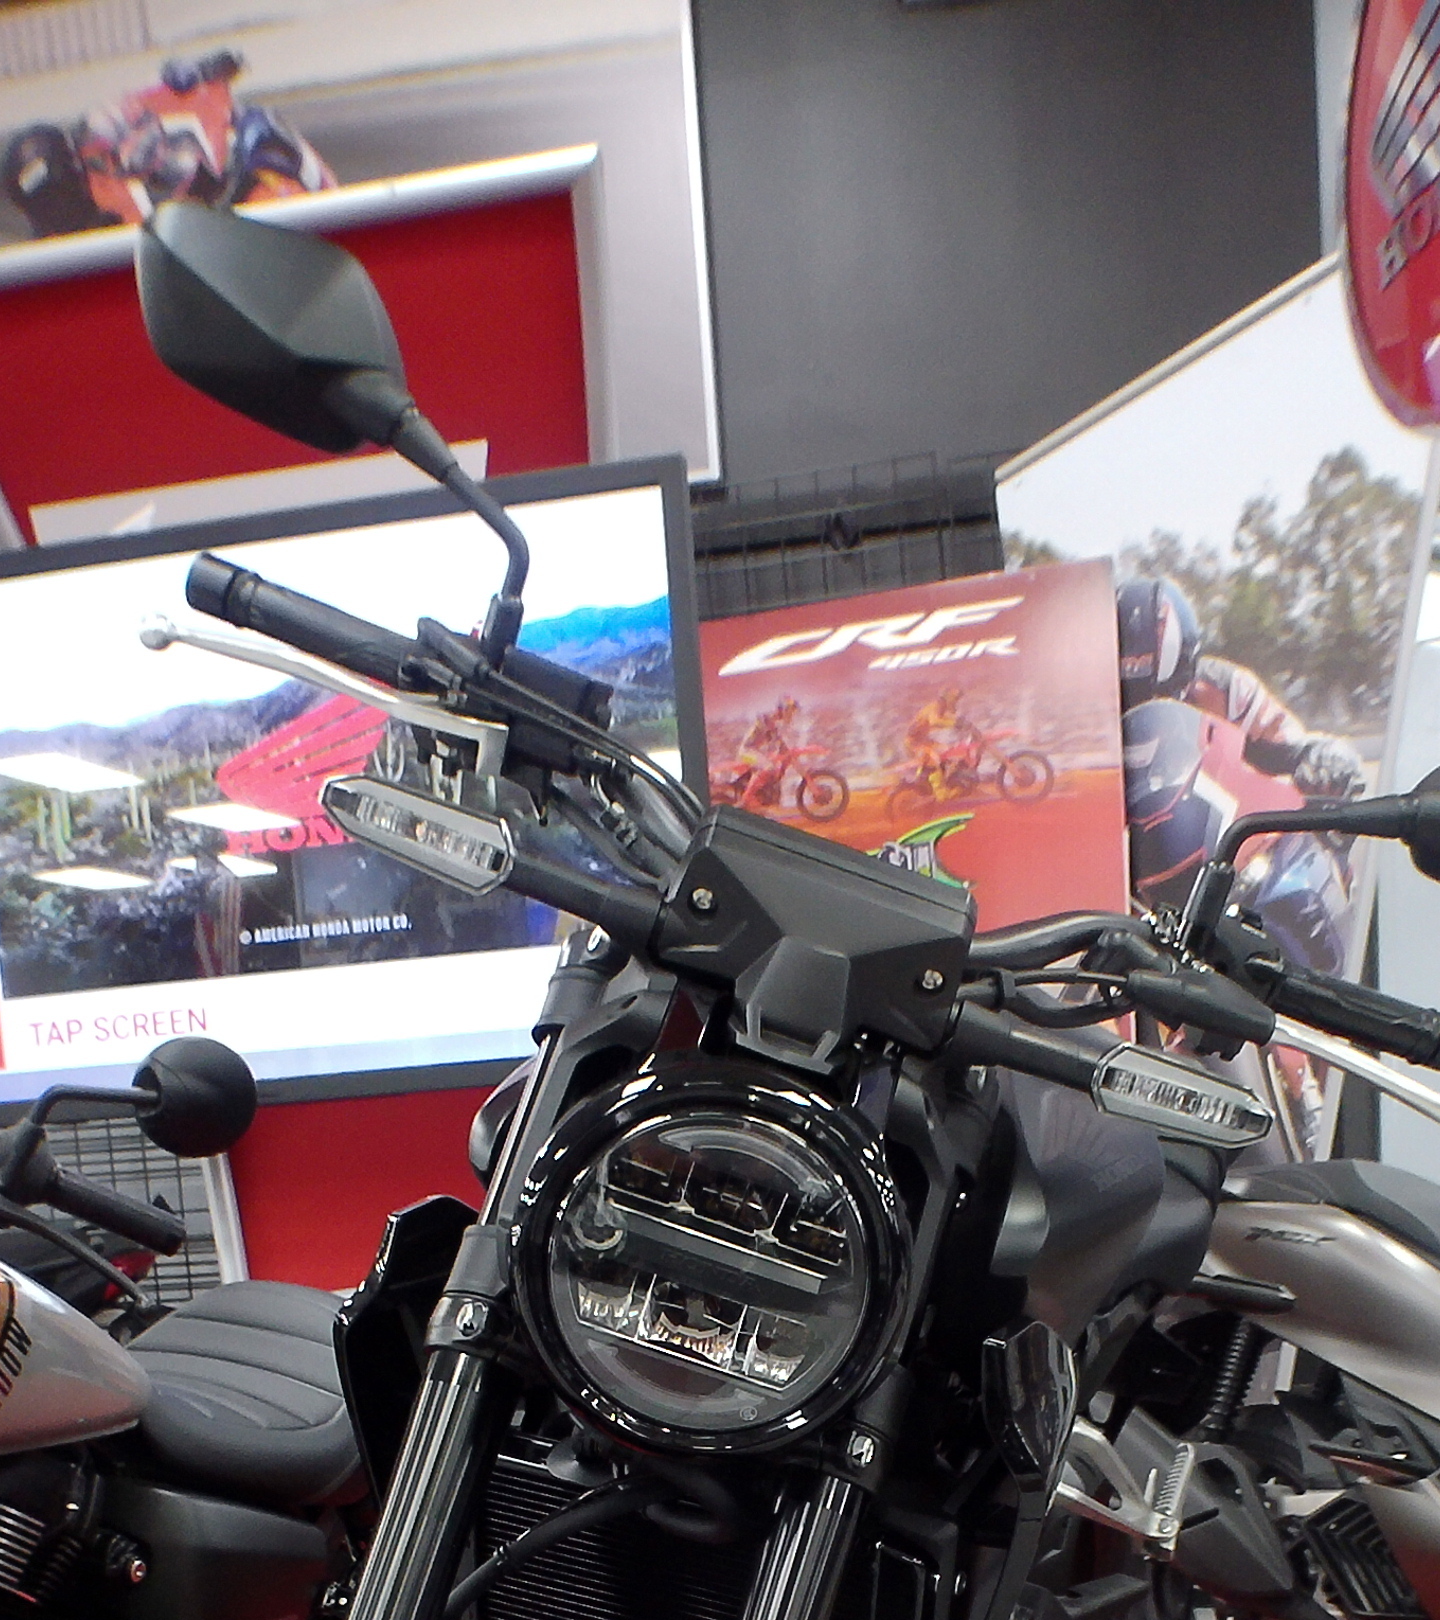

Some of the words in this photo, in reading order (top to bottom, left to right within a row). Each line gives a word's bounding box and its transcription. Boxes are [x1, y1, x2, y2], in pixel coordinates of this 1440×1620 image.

[718, 597, 1025, 676] CRF
[254, 924, 309, 943] AMERICAN
[312, 918, 350, 938] HONDA
[352, 915, 391, 934] MOTOR
[30, 1020, 83, 1046] TAP
[94, 1008, 208, 1043] SCREEN
